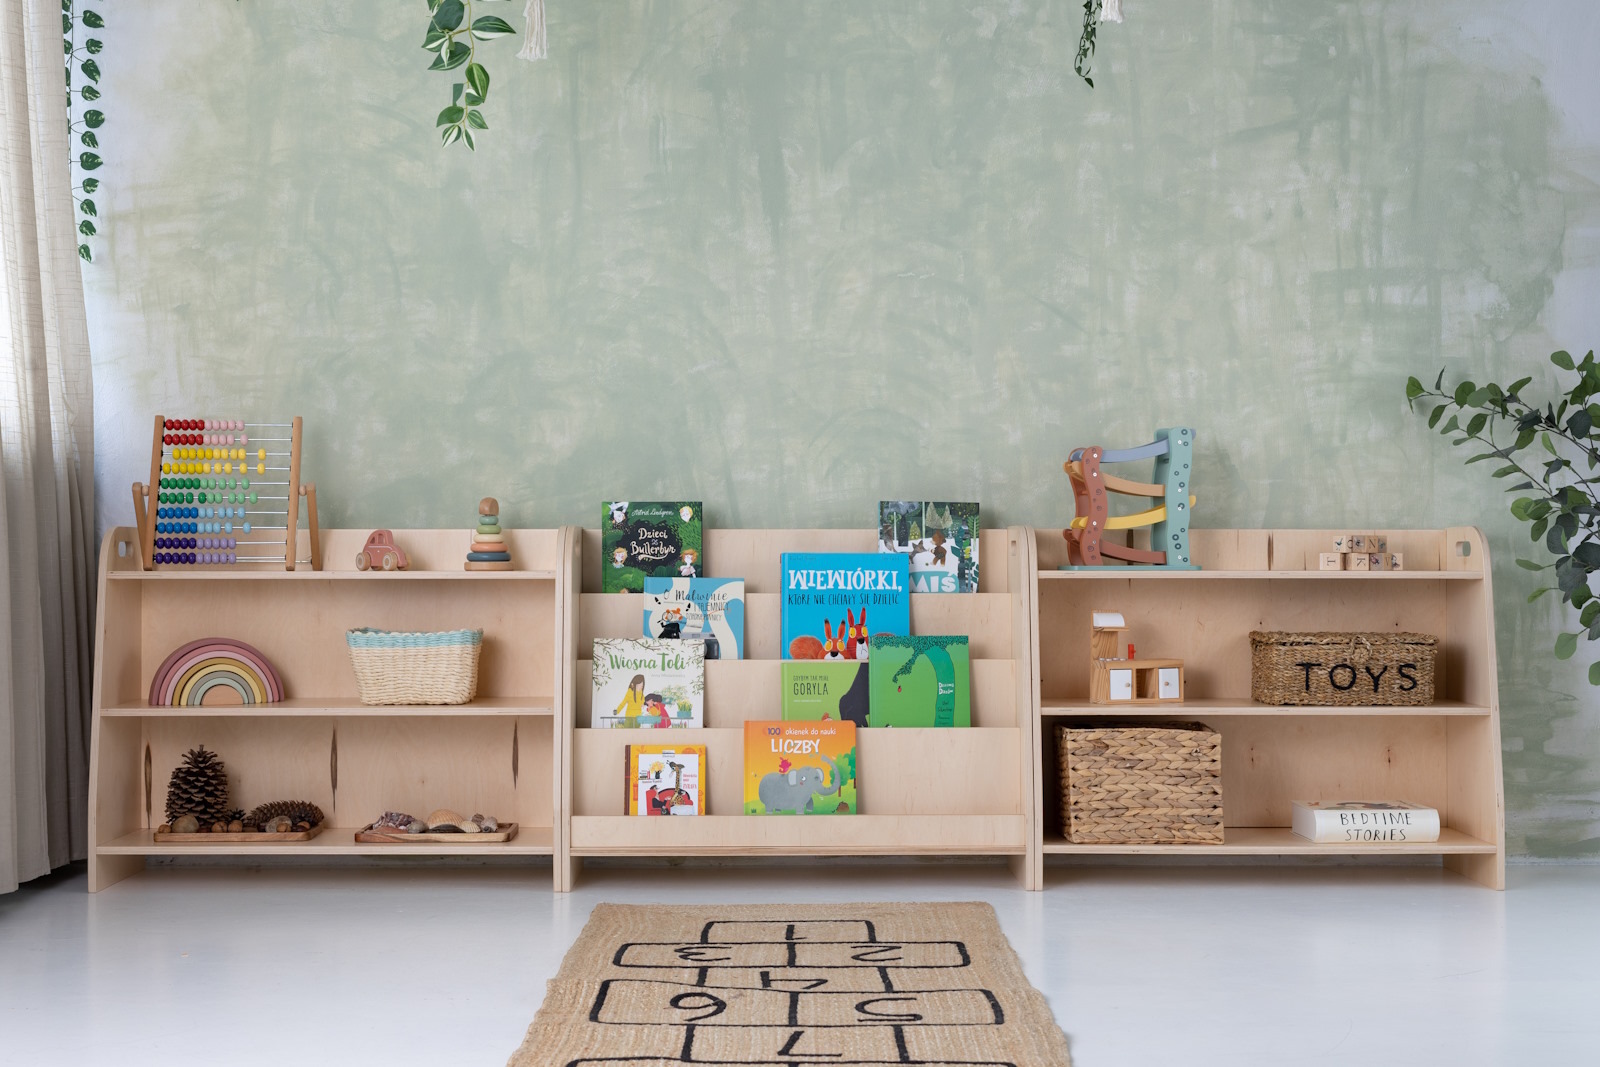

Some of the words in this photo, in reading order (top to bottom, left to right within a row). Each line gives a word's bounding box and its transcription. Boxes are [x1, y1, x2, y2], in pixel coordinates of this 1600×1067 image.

[638, 527, 668, 540] Dzieci
[788, 567, 903, 593] WIEWIÓRKI,
[909, 573, 956, 593] MIŚ
[813, 593, 824, 605] NIE
[609, 653, 657, 671] Wiosna
[657, 652, 686, 671] Toli
[1295, 663, 1418, 693] TOYS
[793, 682, 829, 696] GORYLA
[767, 727, 781, 736] 100
[785, 727, 809, 736] okienek
[811, 727, 818, 736] do
[820, 727, 837, 736] nauki
[771, 738, 820, 754] LICZBY
[1340, 812, 1412, 826] BEDTIME
[1345, 828, 1407, 841] STORIES
[673, 946, 732, 962] 3
[850, 946, 903, 962] 2
[760, 971, 828, 990] 4
[855, 997, 923, 1022] 5
